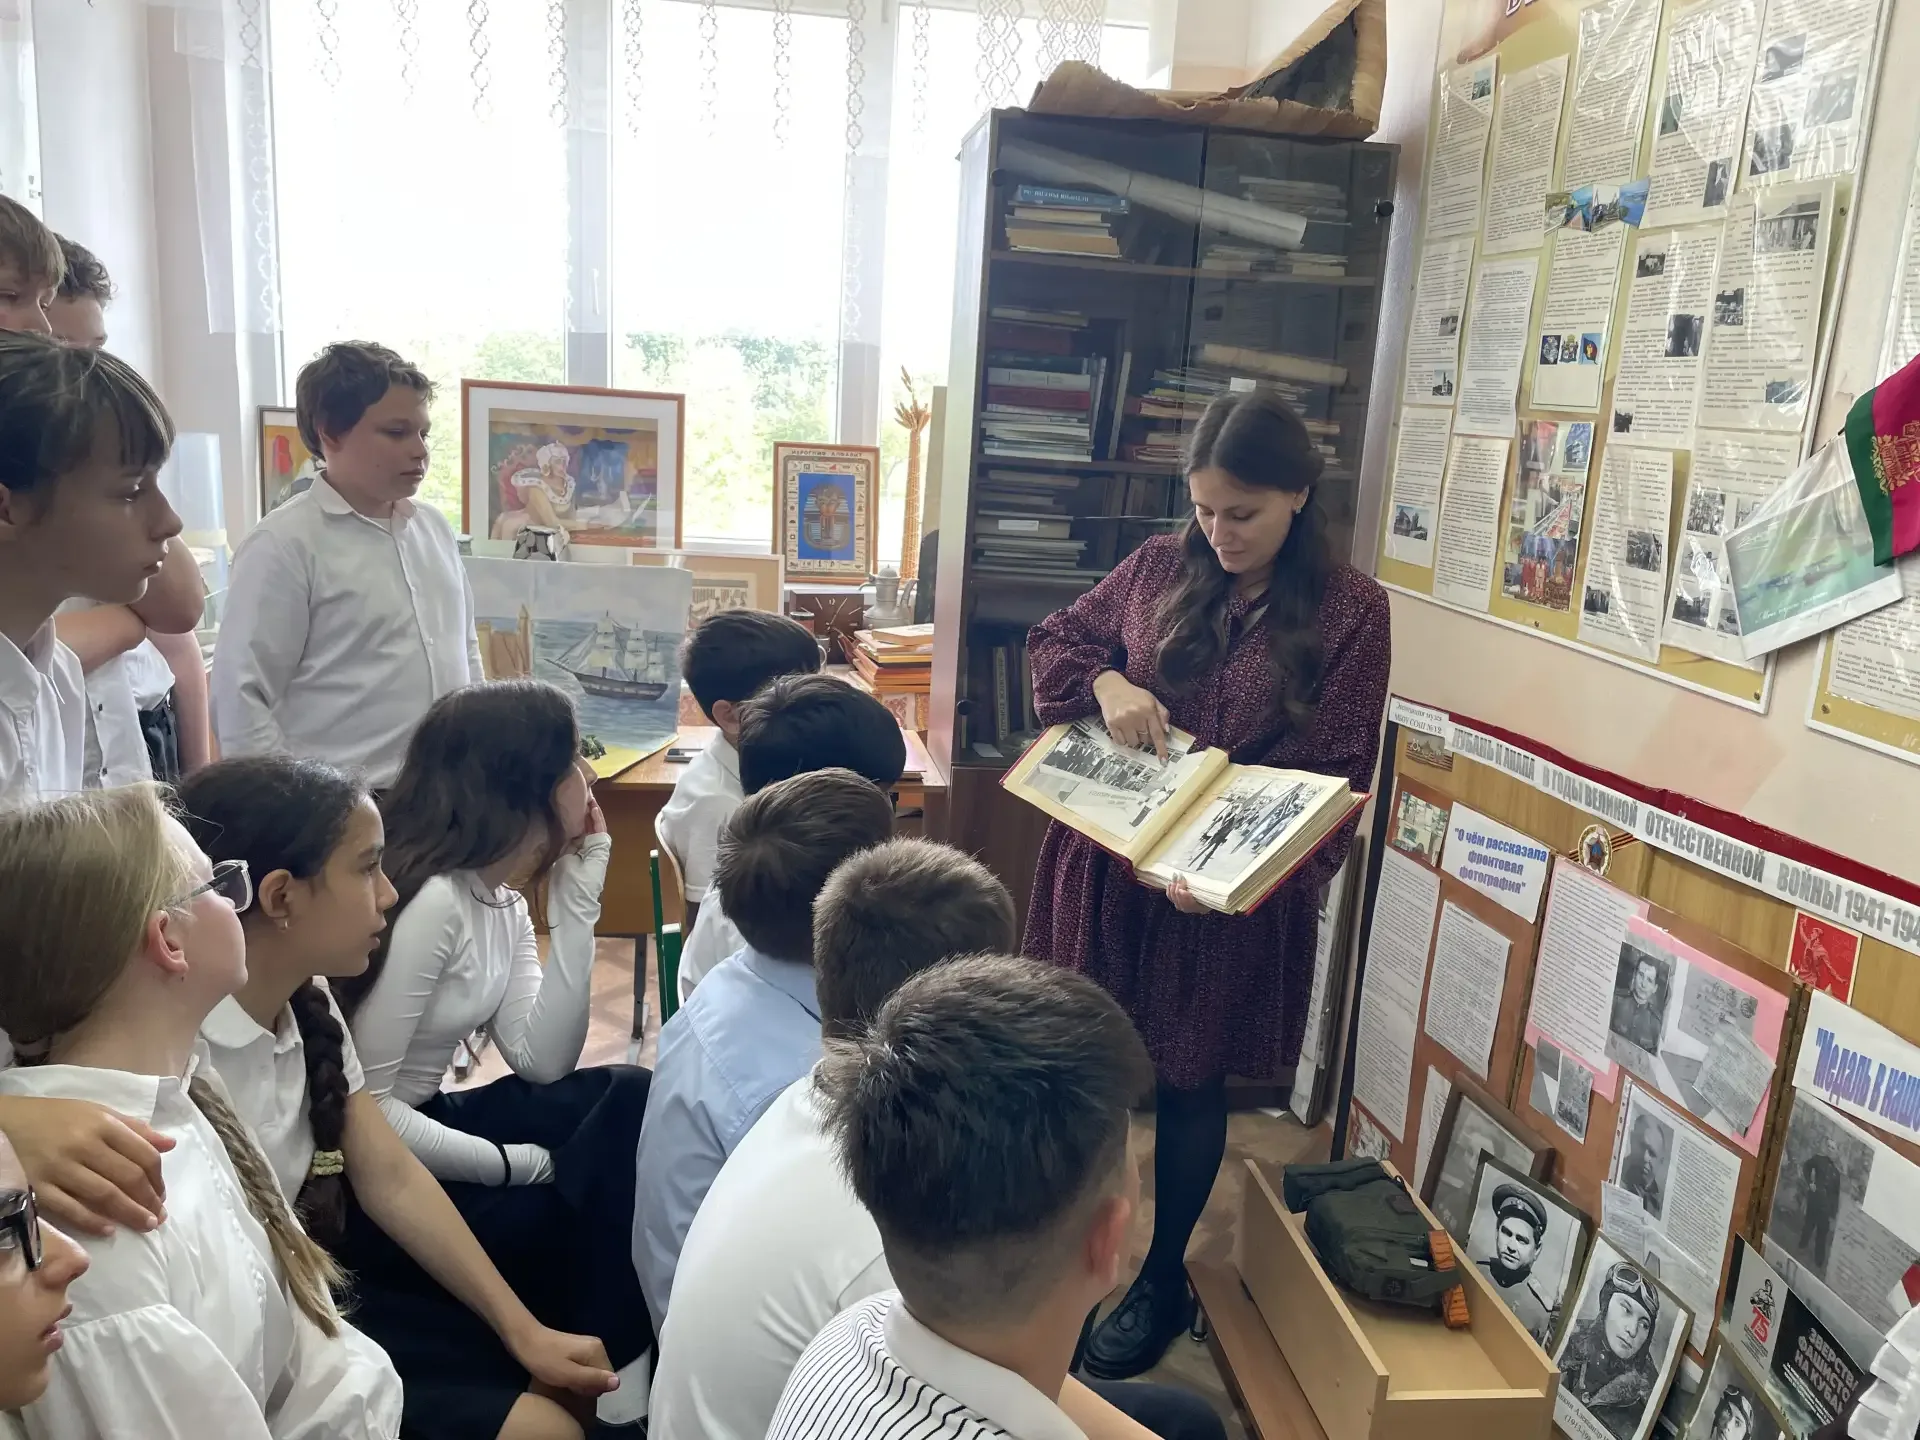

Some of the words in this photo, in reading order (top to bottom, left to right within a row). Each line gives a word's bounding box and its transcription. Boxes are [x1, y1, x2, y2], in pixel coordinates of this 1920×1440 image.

[1409, 717, 1425, 729] СОШ
[1466, 831, 1486, 847] чём
[1486, 837, 1548, 863] рассказала
[1503, 747, 1535, 780] АНАПА
[1543, 766, 1551, 788] В
[1551, 769, 1583, 802] ГОДЫ
[1584, 784, 1638, 828] ВЕЛИКОЙ
[1645, 810, 1766, 883] ОТЕЧЕСТВЕННОЙ
[1776, 861, 1842, 915] ВОЙНЫ
[1468, 850, 1524, 876] фронтовая
[1459, 865, 1526, 894] фотография"
[1813, 1027, 1872, 1106] "Медаль
[1750, 1305, 1770, 1343] 75
[1795, 1349, 1810, 1376] НА
[1575, 1407, 1603, 1439] Александр
